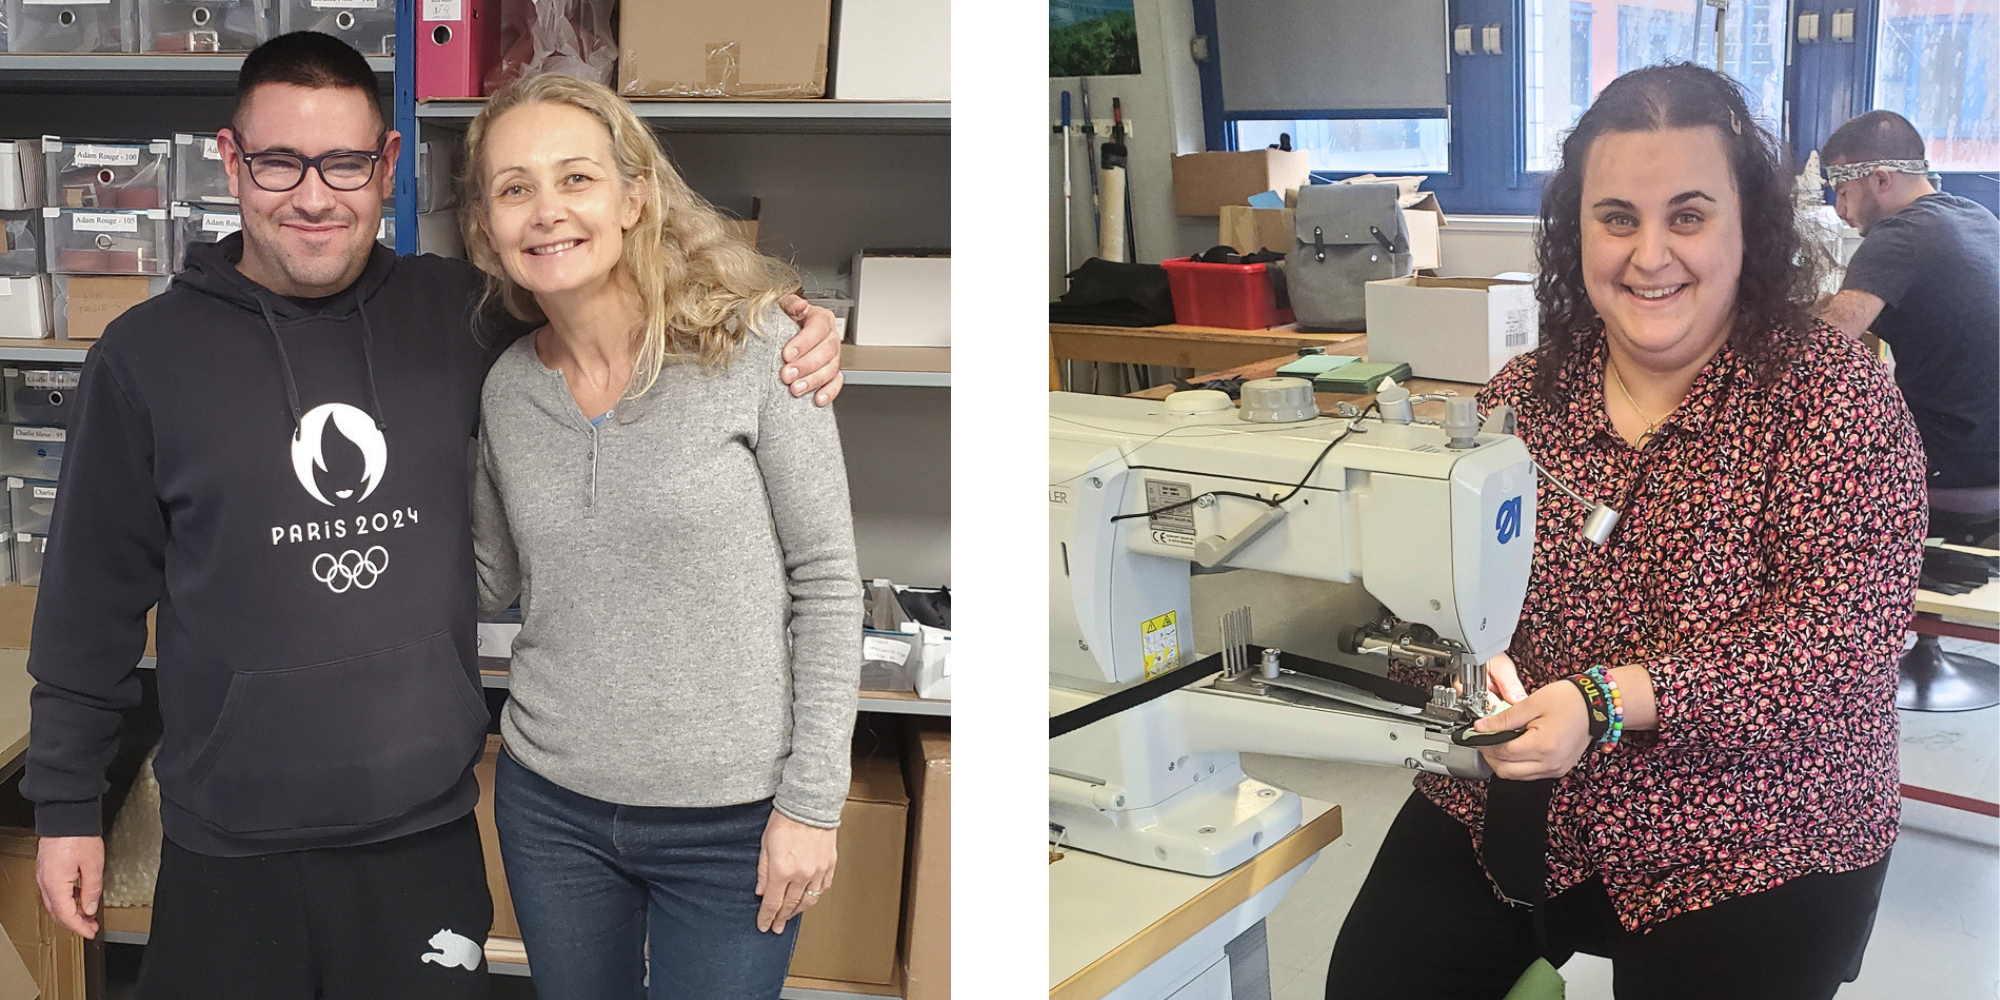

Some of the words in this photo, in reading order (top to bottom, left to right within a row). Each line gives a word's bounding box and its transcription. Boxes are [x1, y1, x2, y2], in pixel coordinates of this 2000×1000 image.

[98, 153, 119, 161] Rouge
[75, 216, 95, 224] Adam
[96, 217, 117, 225] Rouge
[205, 218, 225, 226] Adam
[1271, 412, 1278, 420] 4
[355, 507, 418, 535] 2024
